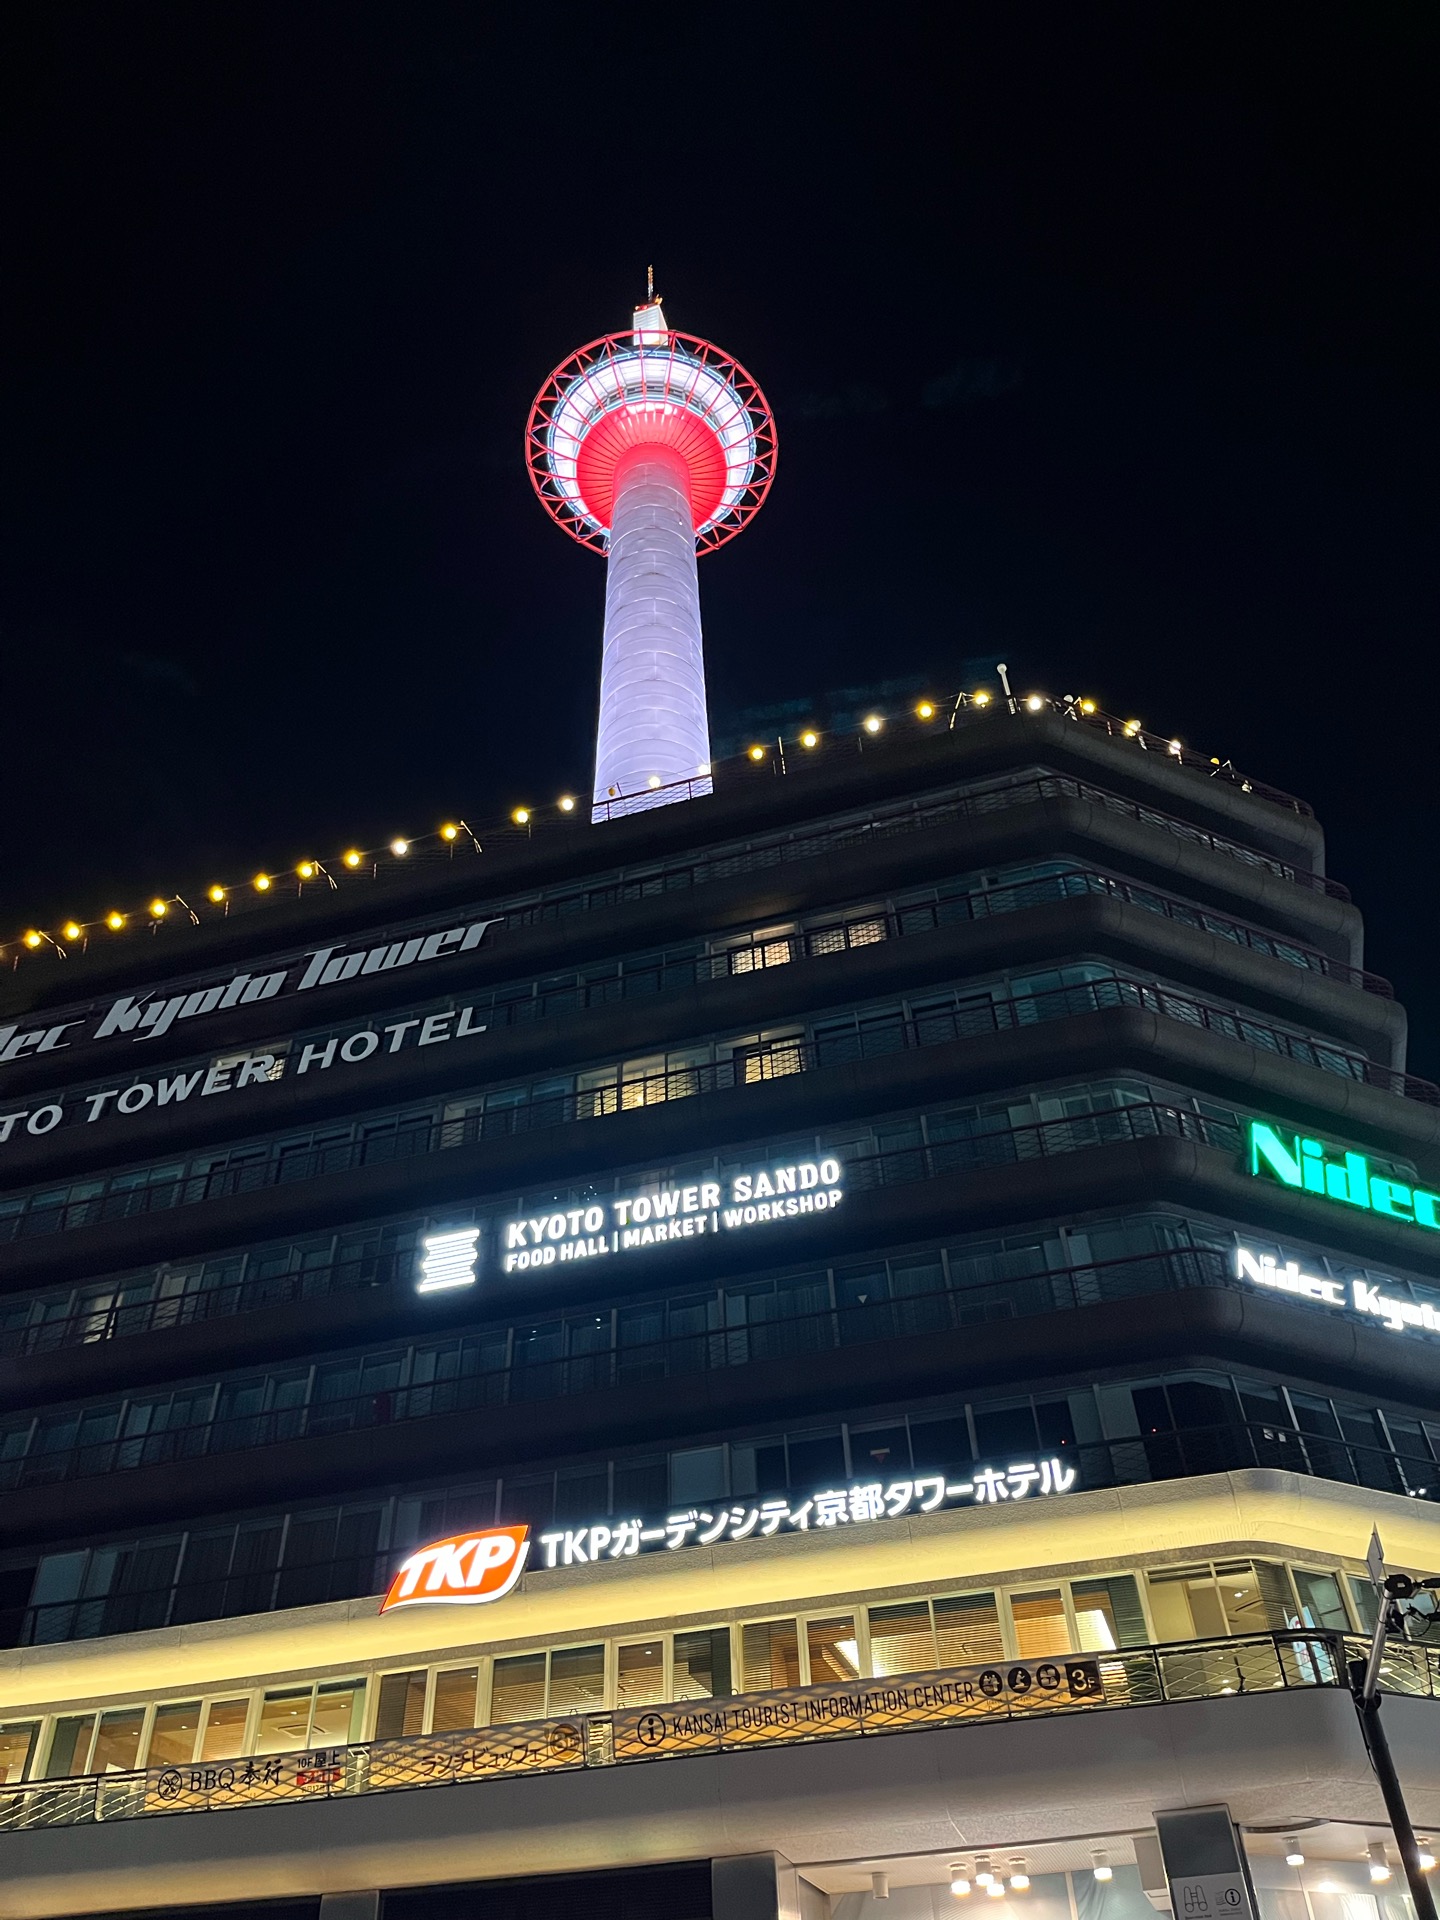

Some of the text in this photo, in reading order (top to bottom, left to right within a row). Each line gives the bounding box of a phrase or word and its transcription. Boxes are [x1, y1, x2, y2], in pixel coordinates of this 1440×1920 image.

[93, 970, 288, 1042] Kyoto
[298, 918, 504, 991] Tower
[86, 1055, 275, 1123] TOWER
[297, 1007, 487, 1074] HOTEL
[508, 1159, 840, 1248] KYOTO TOWER SANDO
[1252, 1122, 1440, 1230] Nidec
[506, 1190, 842, 1272] FOOD HALL MARKET WORKSHOP
[1237, 1248, 1347, 1306] Nidec
[541, 1458, 1076, 1568] TKPガーデンシティ京都タワーホテル
[399, 1535, 516, 1597] TKP
[673, 1711, 727, 1737] KANSAI
[732, 1702, 799, 1730] TOURIST
[805, 1689, 908, 1722] INFORMATION
[913, 1681, 975, 1708] CENTER
[1070, 1668, 1095, 1692] 3F
[421, 1745, 543, 1777] ランチビュッフェ
